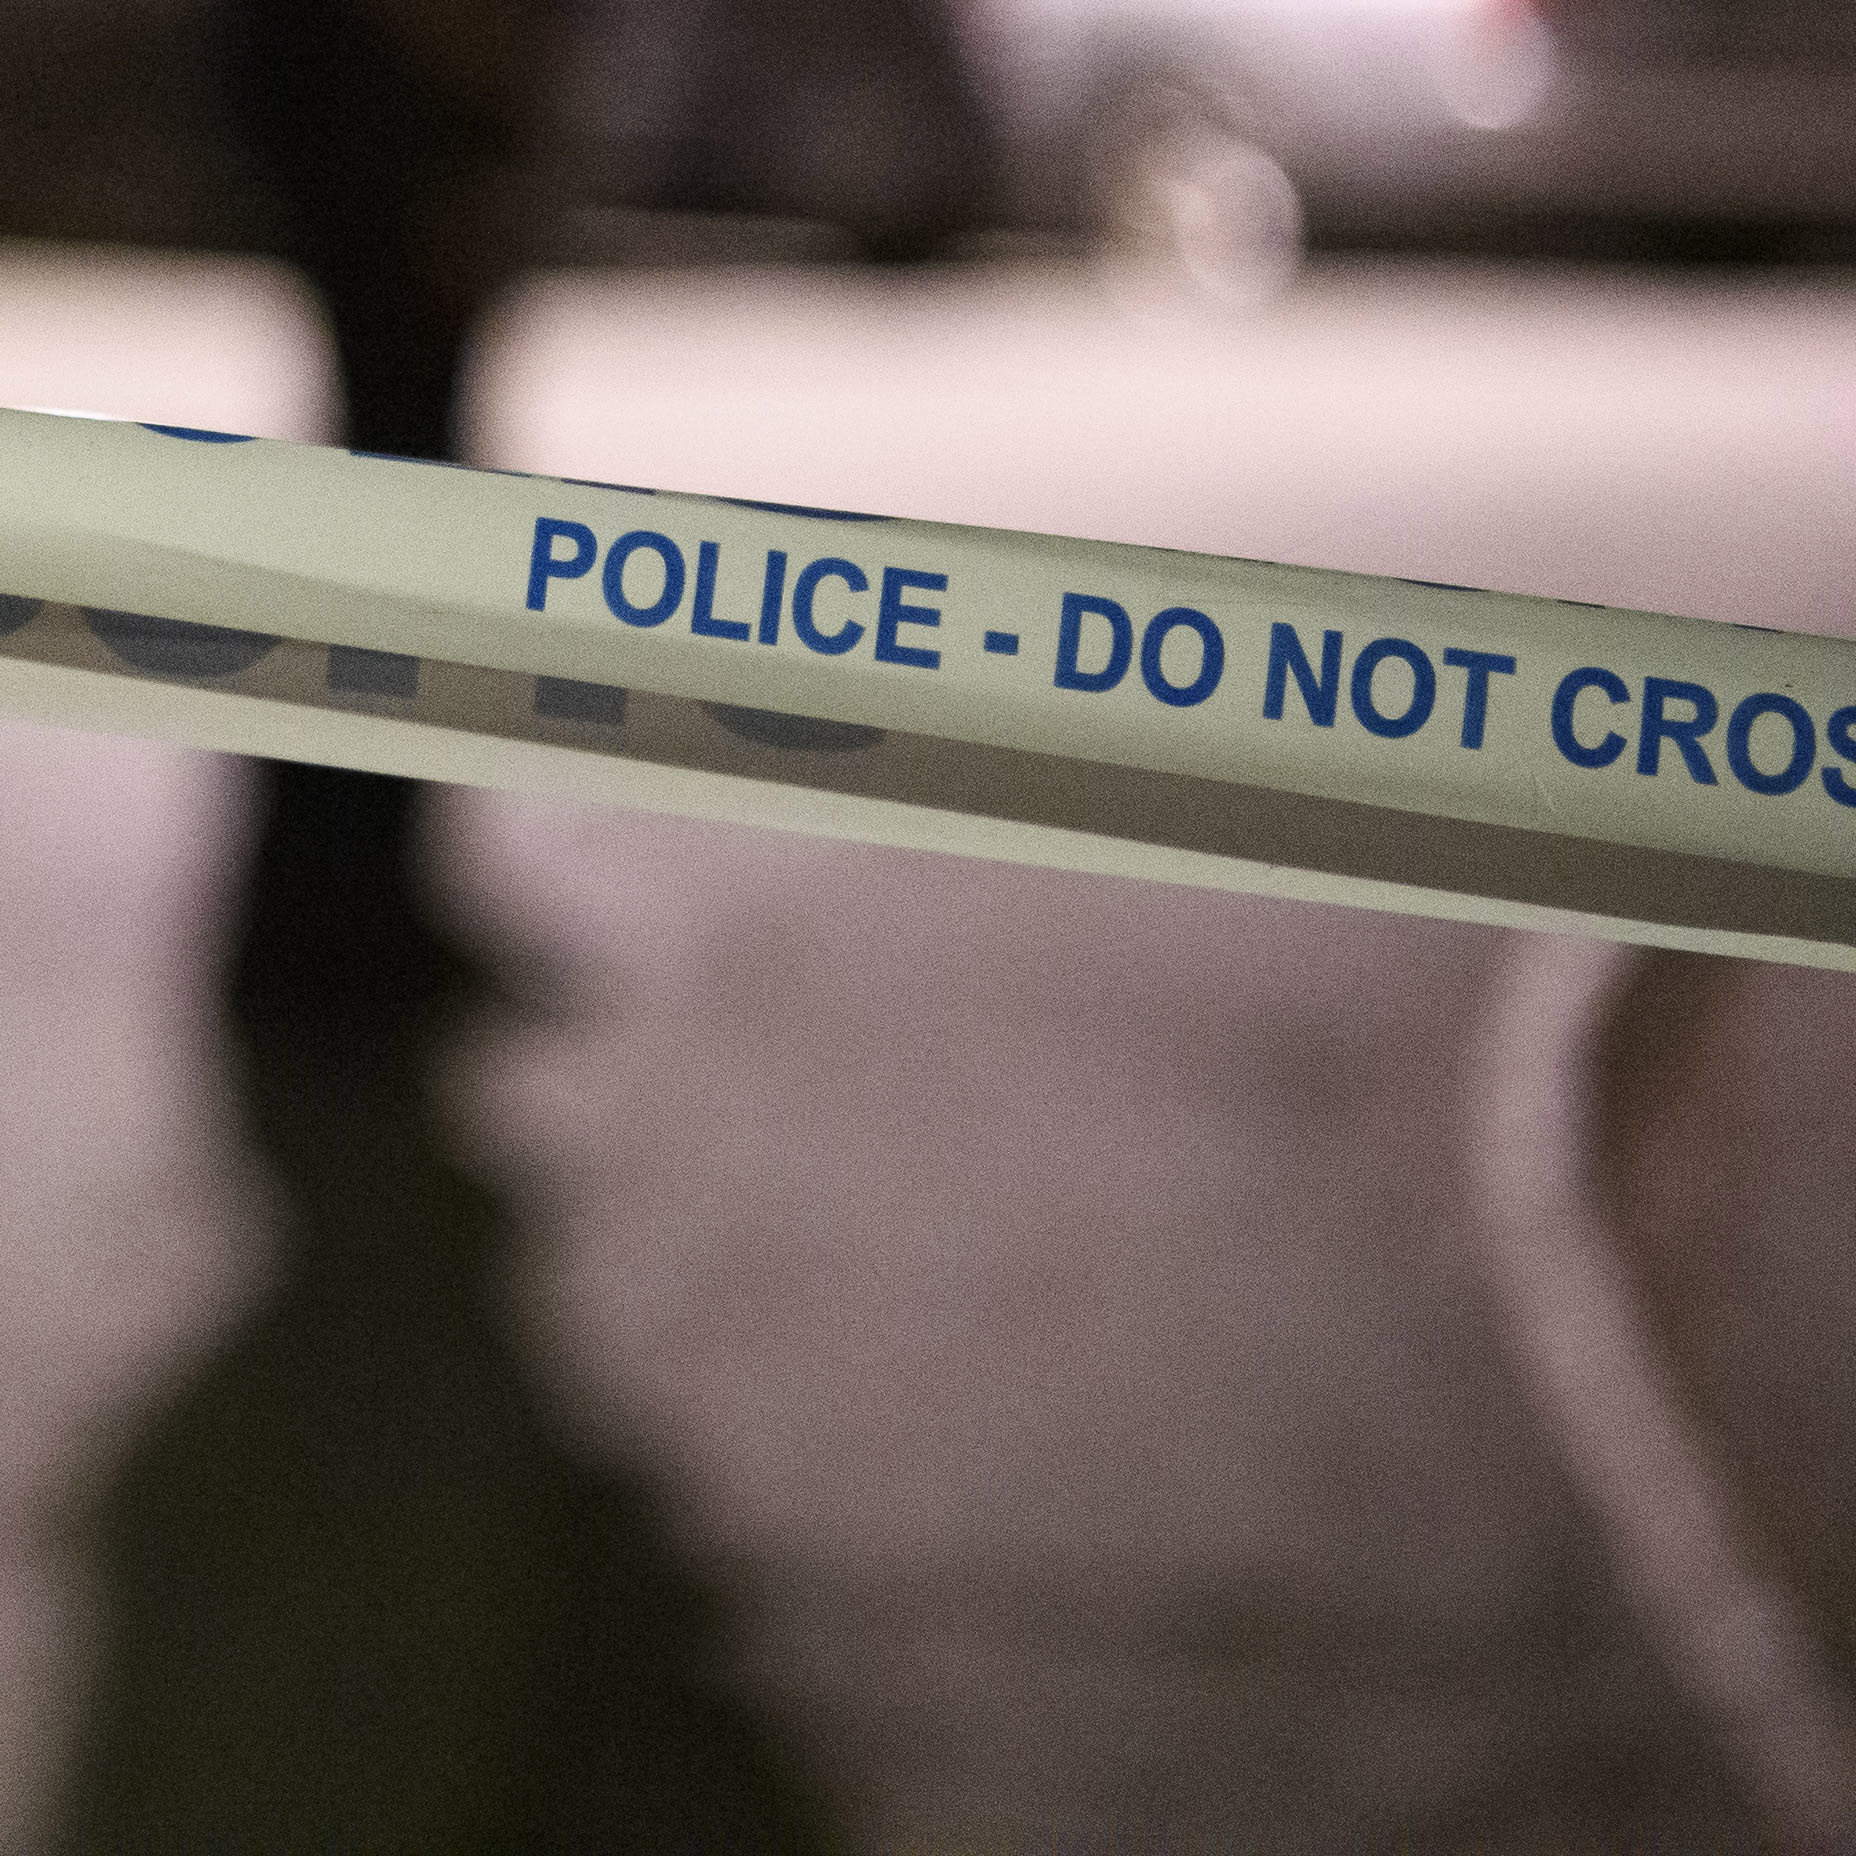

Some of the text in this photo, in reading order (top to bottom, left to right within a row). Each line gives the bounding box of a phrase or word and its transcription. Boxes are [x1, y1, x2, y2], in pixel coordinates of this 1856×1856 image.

[526, 517, 948, 670] POLICE
[1053, 592, 1225, 708] DO
[1262, 622, 1517, 750] NOT
